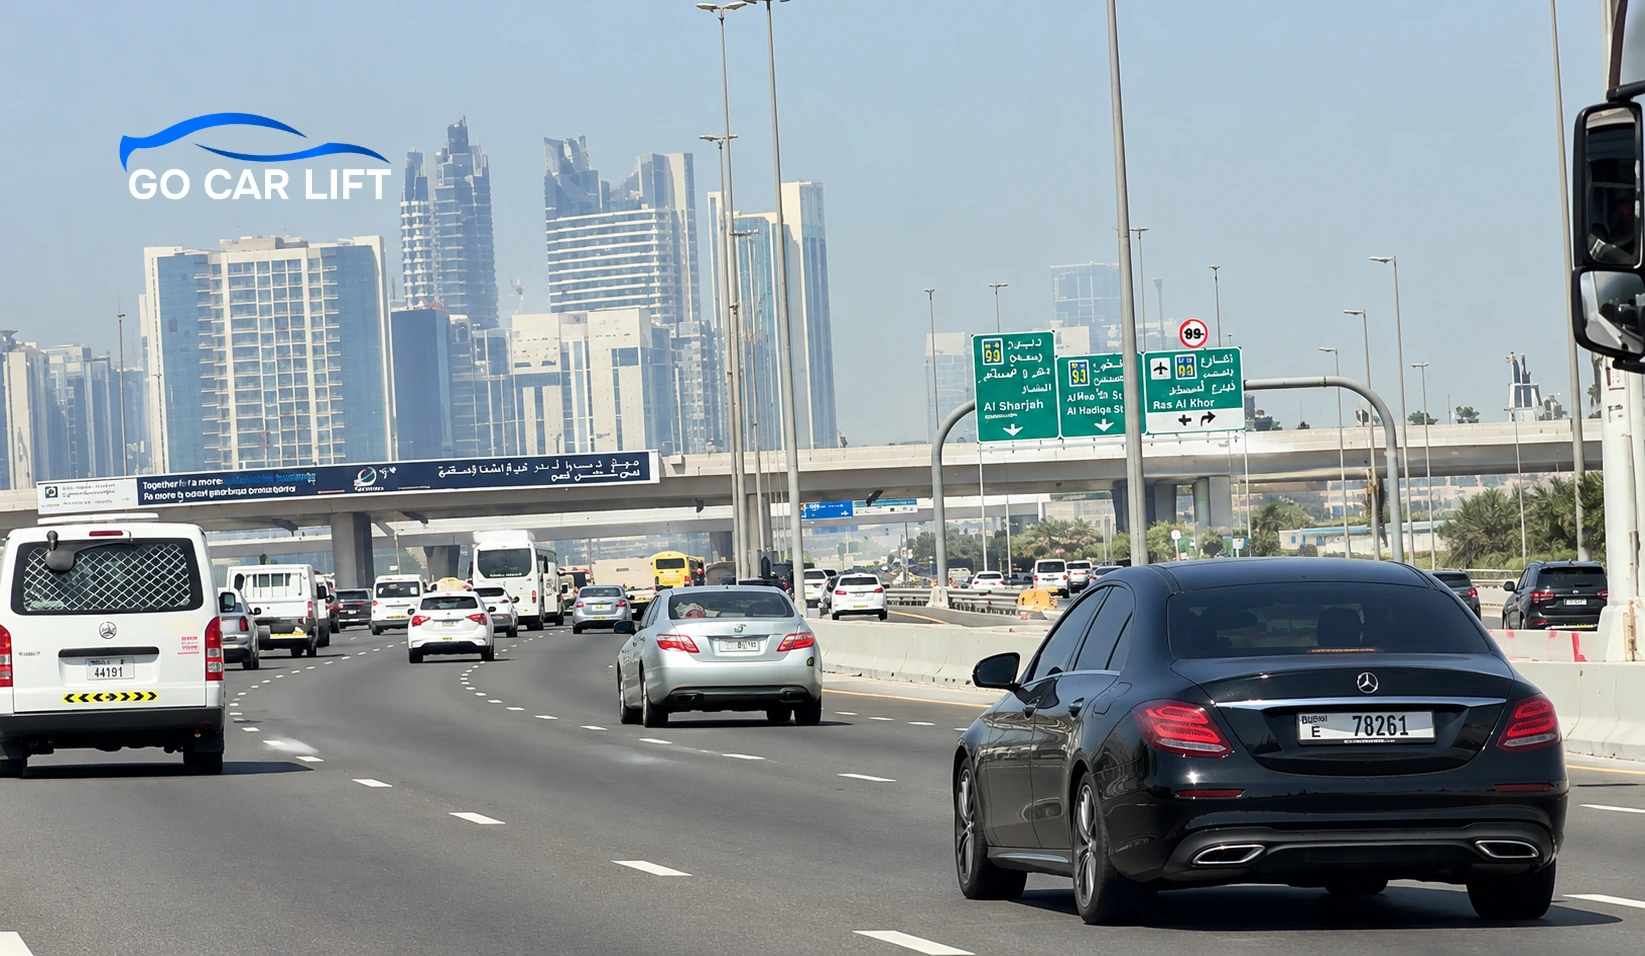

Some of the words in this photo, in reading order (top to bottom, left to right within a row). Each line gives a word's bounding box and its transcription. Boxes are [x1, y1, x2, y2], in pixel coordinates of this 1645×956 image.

[983, 401, 996, 411] Al
[999, 398, 1044, 412] Sharjah
[1153, 400, 1173, 410] Ras
[1175, 399, 1187, 409] Al
[1190, 398, 1215, 408] Khor
[1066, 406, 1077, 415] Al
[143, 479, 179, 491] Together
[94, 666, 123, 678] 44191
[1311, 725, 1321, 738] E
[1352, 715, 1409, 737] 78261
